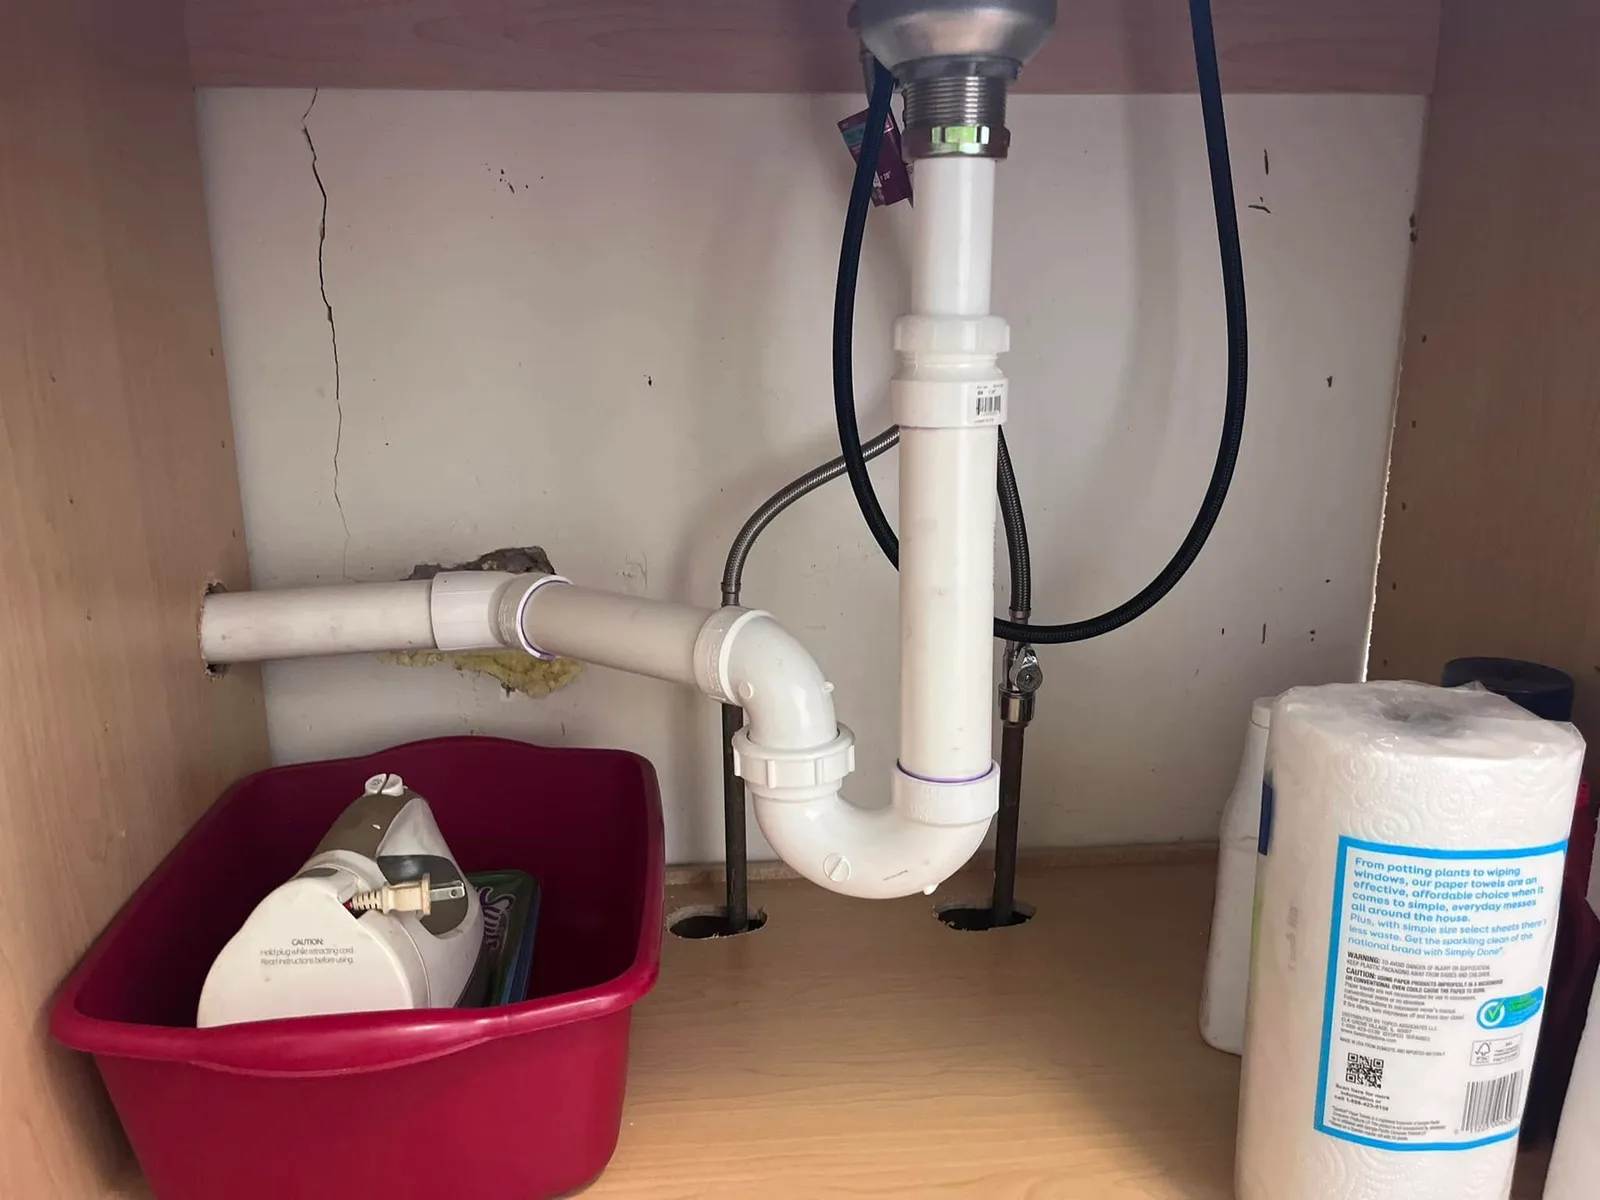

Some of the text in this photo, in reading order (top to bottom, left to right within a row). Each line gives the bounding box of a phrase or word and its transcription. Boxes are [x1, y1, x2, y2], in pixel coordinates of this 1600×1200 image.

[1355, 857, 1384, 870] From
[1387, 863, 1432, 877] potting
[1435, 868, 1470, 878] plants
[1487, 867, 1521, 877] wiping
[1354, 869, 1537, 890] windows, our paper towels are an
[1353, 881, 1544, 900] effective, affordable choice when it
[1352, 892, 1536, 912] comes to simple, everyday messes
[1351, 903, 1470, 923] all around the house.
[1350, 913, 1374, 926] Plus,
[1377, 918, 1400, 929] with
[1402, 923, 1436, 935] simple
[1439, 925, 1458, 934] size
[1460, 925, 1489, 934] select
[1491, 923, 1520, 933] sheets
[291, 938, 324, 946] CAUTION:
[1349, 924, 1368, 935] less
[1370, 930, 1402, 941] waste.
[1404, 934, 1422, 944] Get
[1425, 937, 1440, 945] the
[1442, 937, 1485, 946] sparkling
[1347, 951, 1380, 963] WARNING:
[1348, 937, 1389, 950] national
[1391, 944, 1422, 955] brand
[1423, 948, 1443, 956] with
[1445, 948, 1475, 957] Simply
[1346, 967, 1376, 979] CAUTION:
